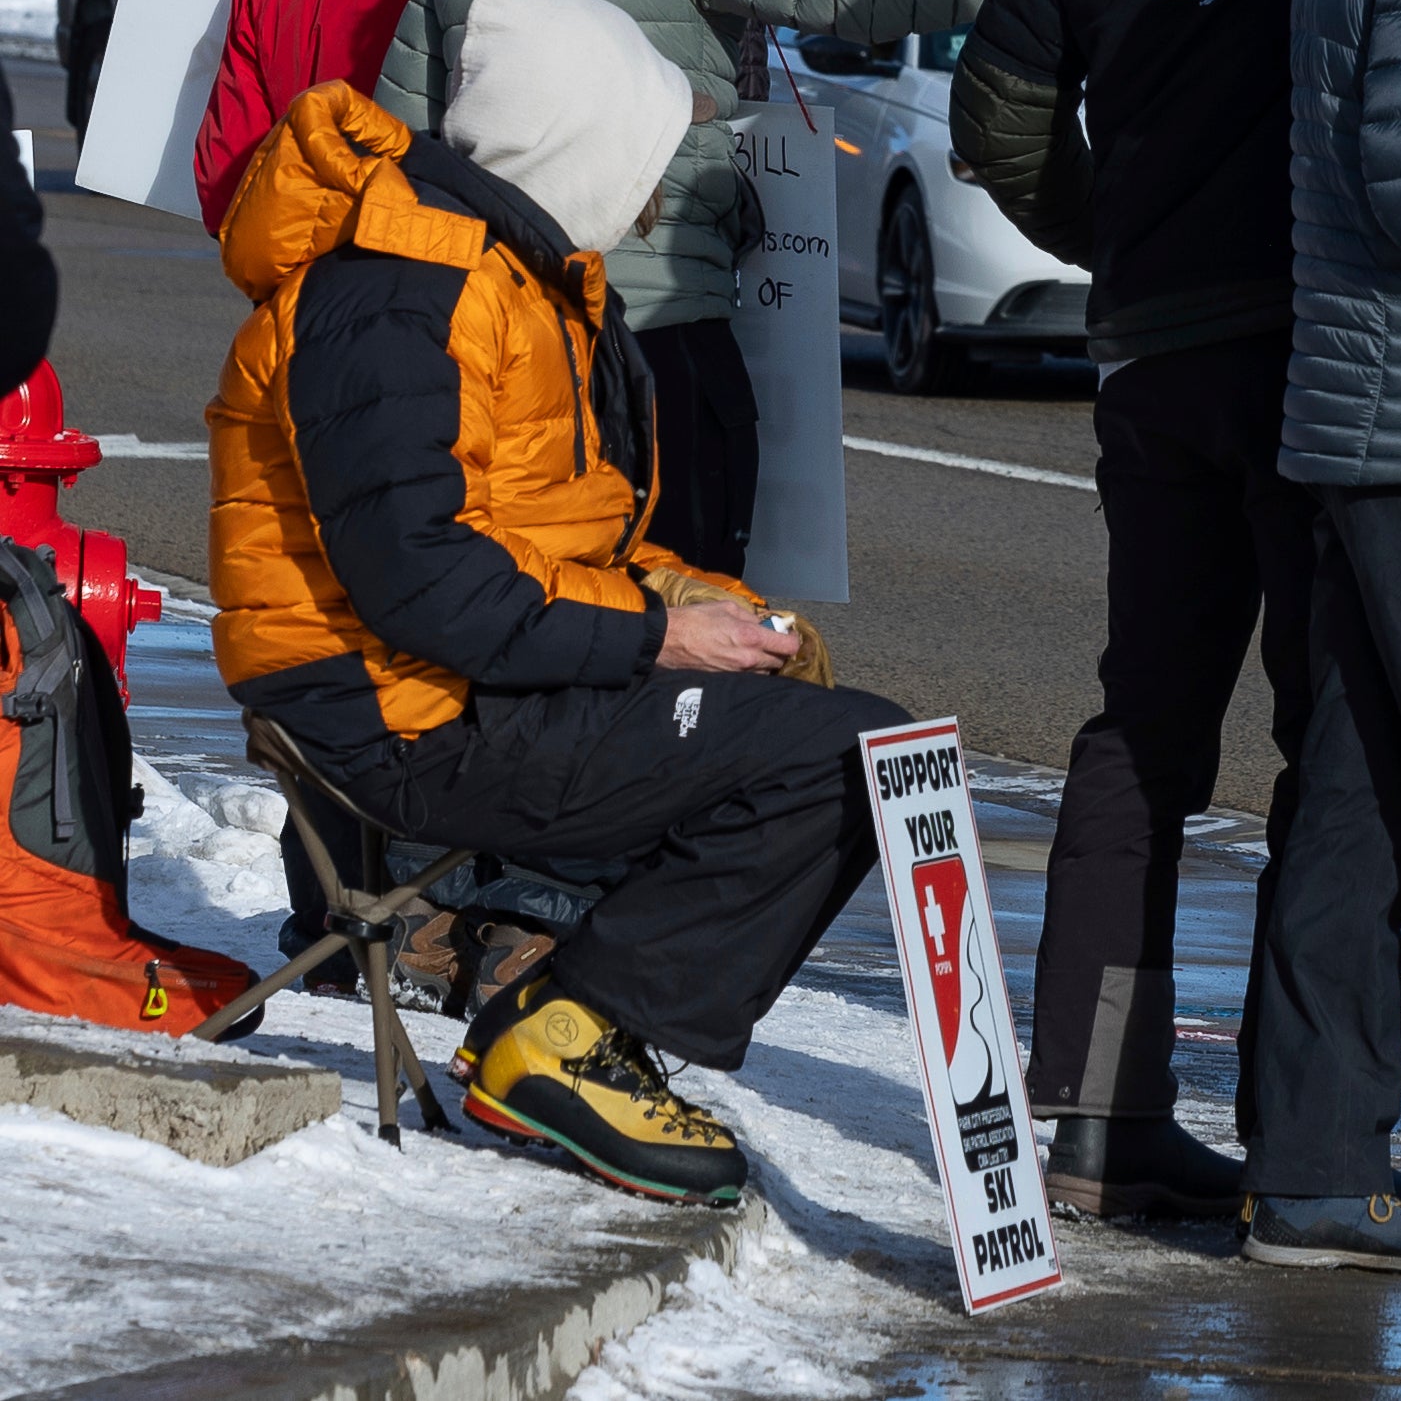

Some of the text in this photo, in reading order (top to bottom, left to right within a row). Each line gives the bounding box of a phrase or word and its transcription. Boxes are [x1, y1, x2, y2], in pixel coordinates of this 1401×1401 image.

[758, 277, 793, 310] OF
[876, 746, 961, 801] SUPPORT
[904, 809, 959, 857] YOUR
[984, 1166, 1017, 1214] SKI
[972, 1217, 1045, 1276] PATROL
